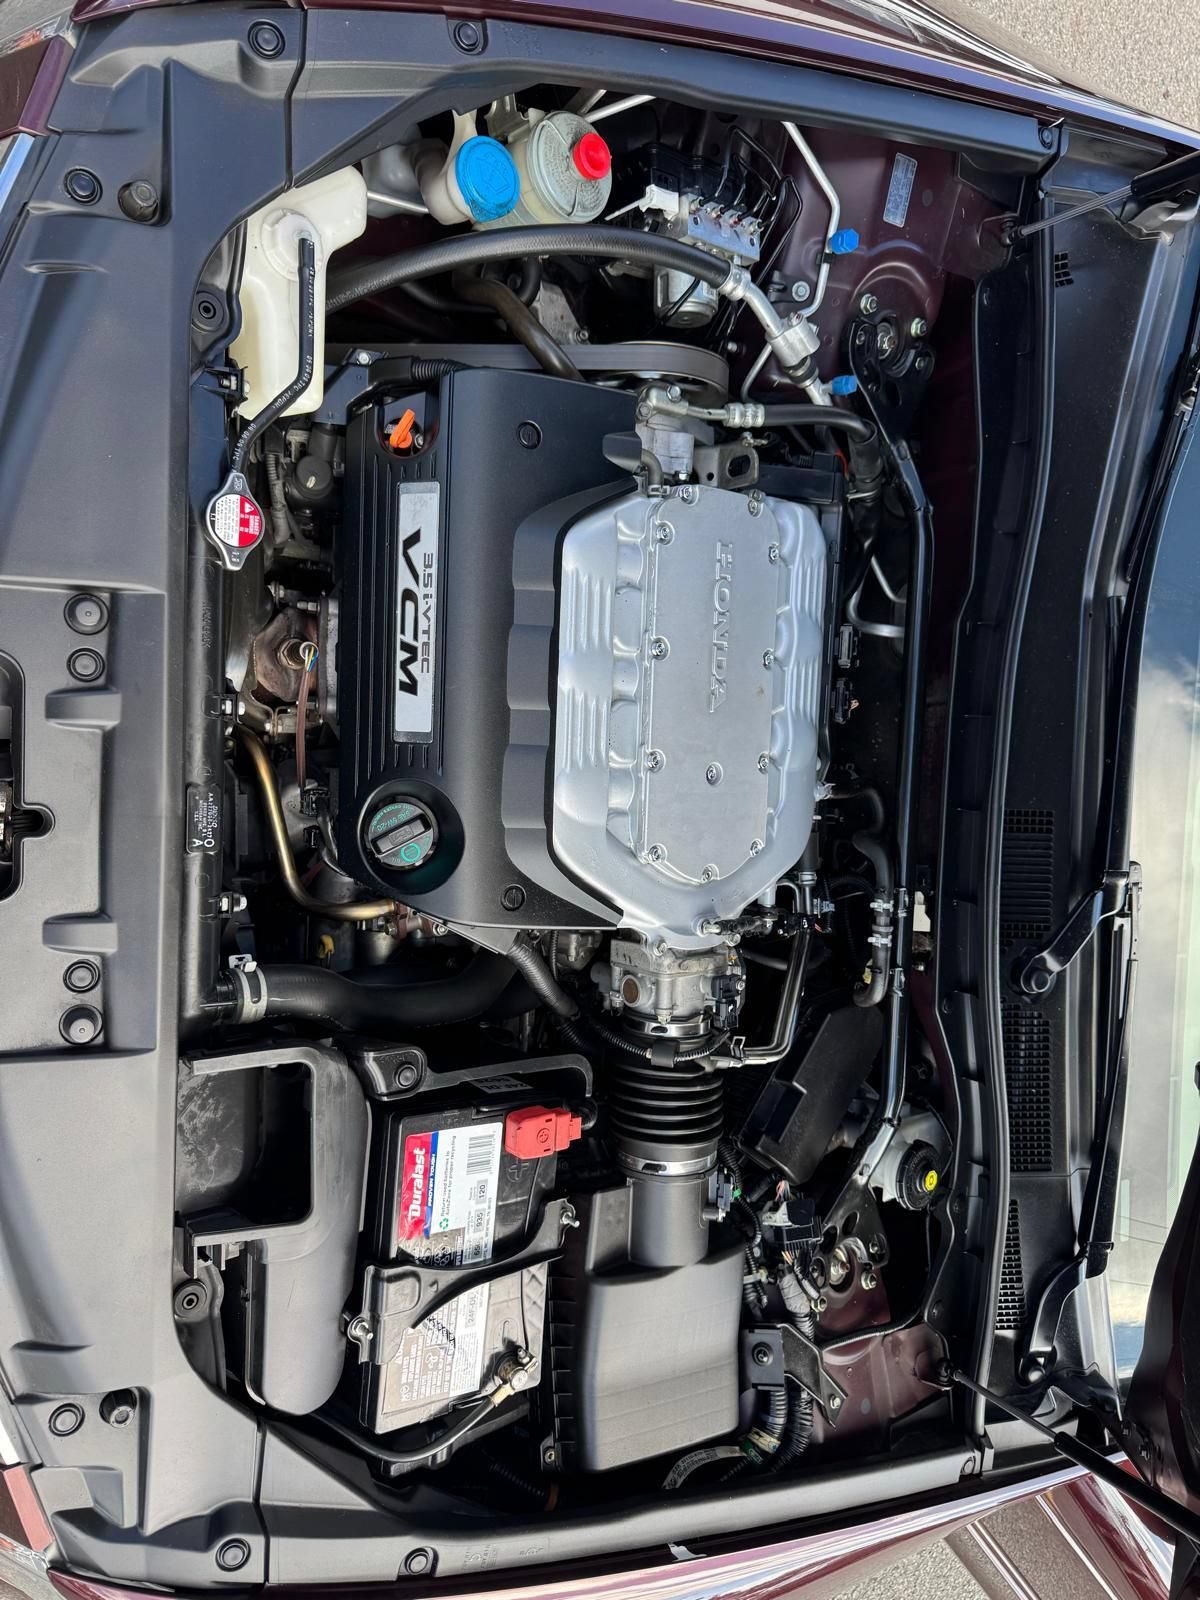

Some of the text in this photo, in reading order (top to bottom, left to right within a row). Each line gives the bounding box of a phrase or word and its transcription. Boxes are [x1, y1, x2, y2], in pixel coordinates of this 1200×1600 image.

[399, 527, 421, 697] VCM
[421, 553, 434, 673] 3.5 i-VTEC
[710, 540, 732, 712] HONDA
[192, 838, 204, 847] A
[407, 1147, 425, 1221] Duralast
[476, 1212, 484, 1228] 935
[478, 1184, 486, 1199] 120
